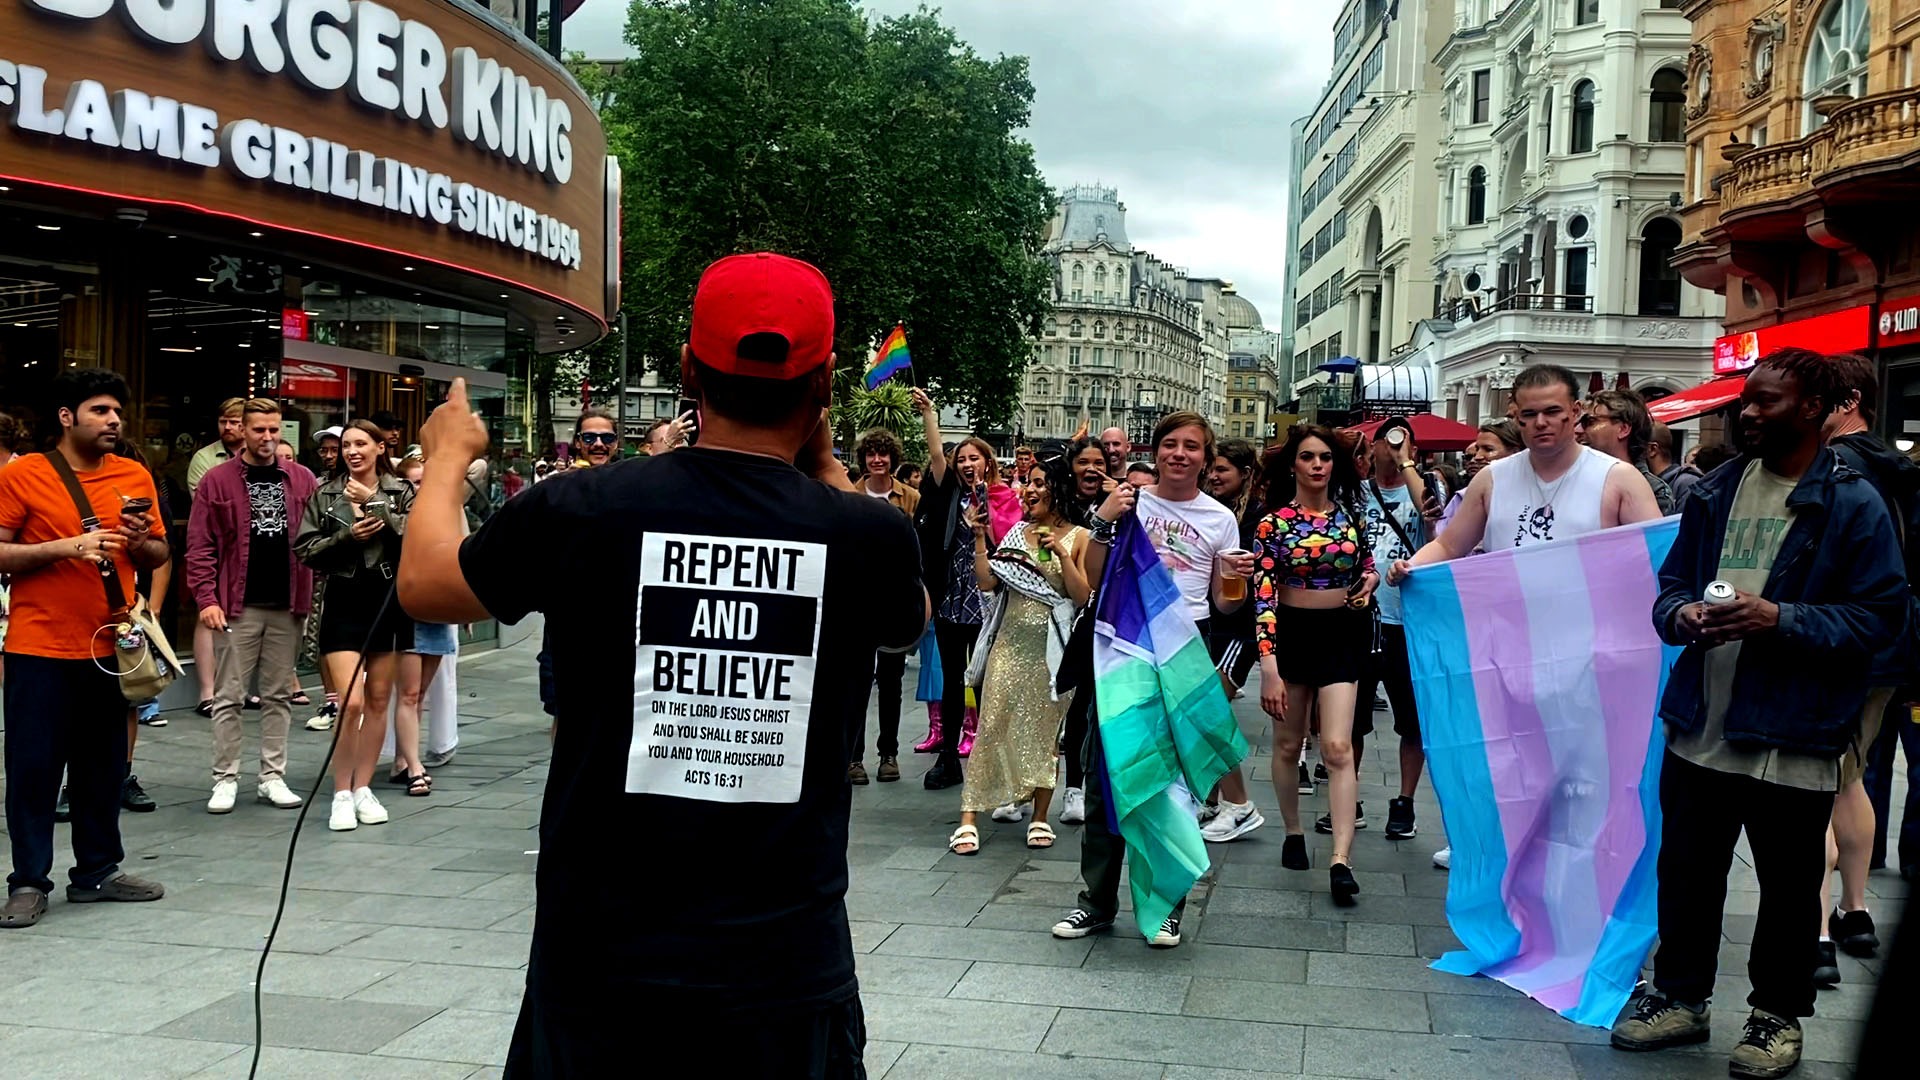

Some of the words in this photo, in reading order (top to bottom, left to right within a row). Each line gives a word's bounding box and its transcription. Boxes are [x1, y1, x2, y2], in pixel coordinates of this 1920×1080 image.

[456, 46, 572, 184] KING
[226, 119, 453, 224] GRILLING
[458, 182, 540, 252] SINCE
[541, 214, 581, 270] 1954
[662, 540, 804, 591] REPENT
[690, 599, 759, 641] AND
[653, 650, 794, 701] BELIEVE
[652, 700, 666, 713] ON
[669, 701, 687, 716] THE
[690, 703, 717, 718] LORD
[720, 706, 751, 721] JESUS
[753, 708, 790, 723] CHRIST
[653, 723, 674, 738] AND
[677, 725, 698, 739] YOU
[700, 726, 731, 743] SHALL
[735, 730, 749, 744] BE
[751, 731, 784, 745] SAVED
[648, 745, 668, 759] YOU
[671, 746, 692, 761] AND
[695, 748, 721, 763] YOUR
[724, 750, 784, 766] HOUSEHOLD
[685, 770, 711, 786] ACTS
[714, 772, 743, 788] 16:31
